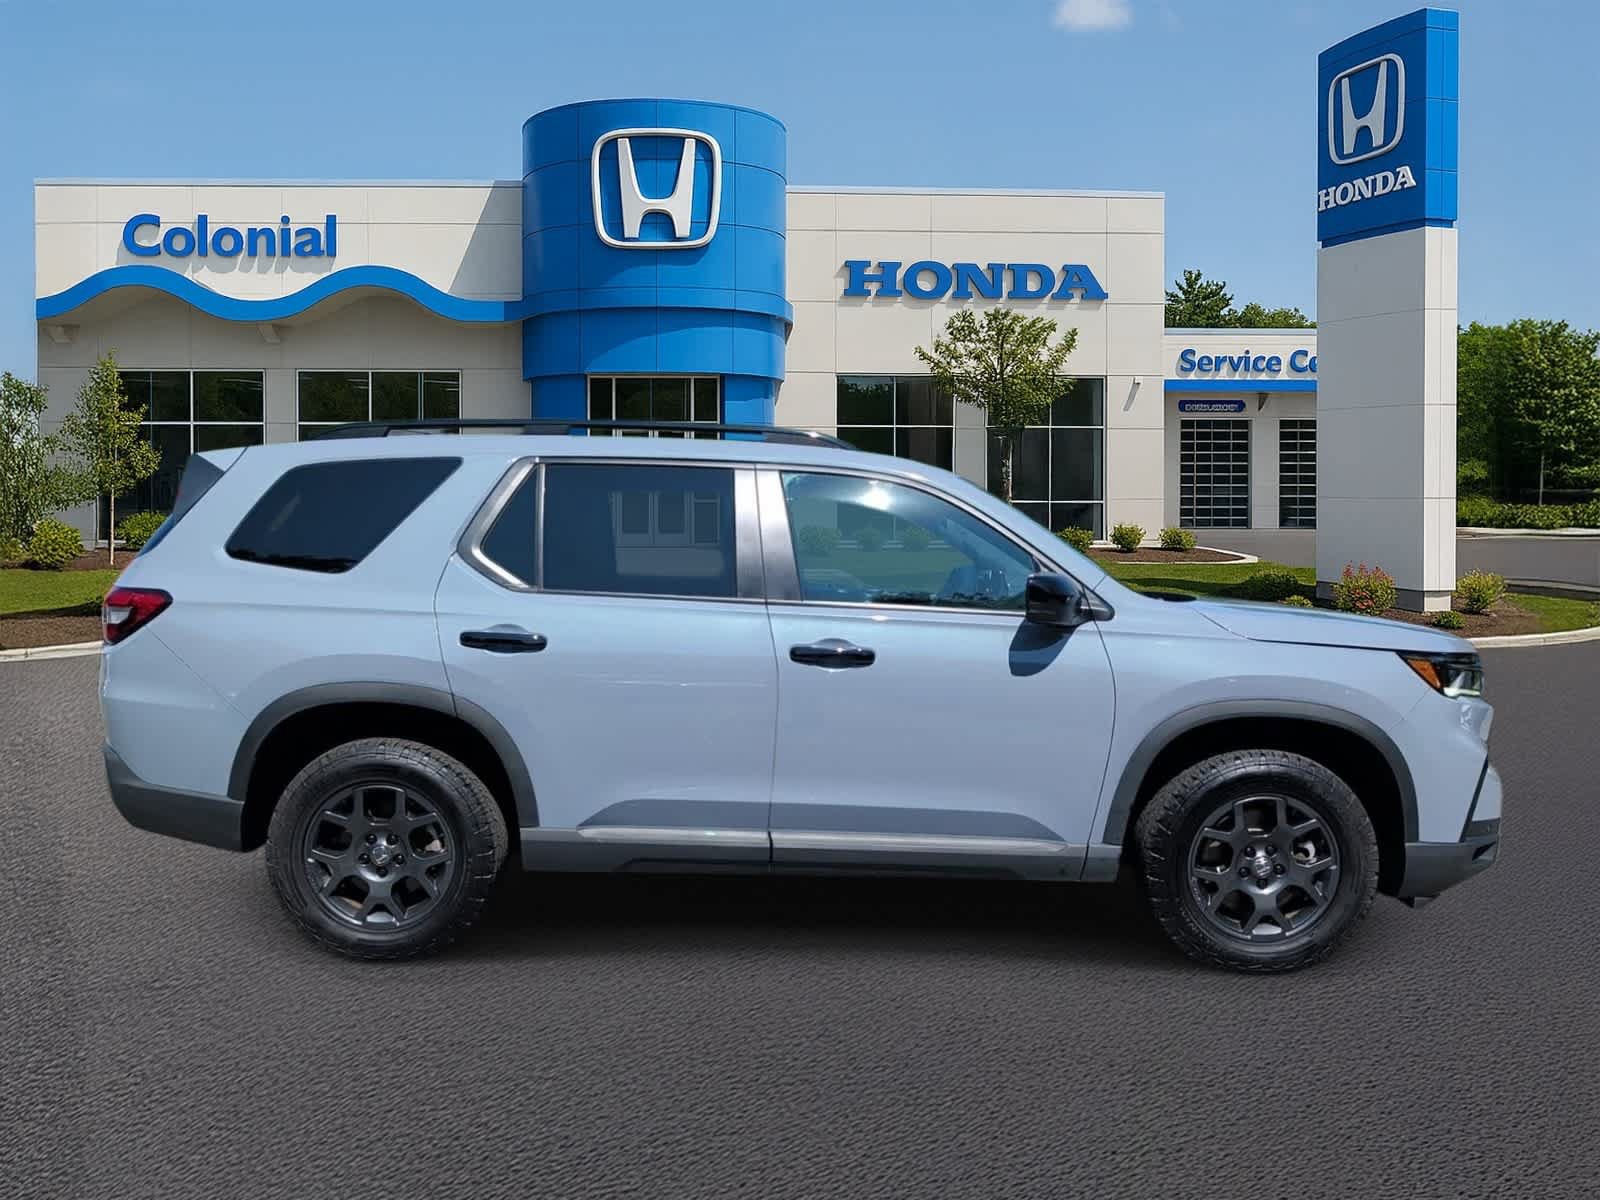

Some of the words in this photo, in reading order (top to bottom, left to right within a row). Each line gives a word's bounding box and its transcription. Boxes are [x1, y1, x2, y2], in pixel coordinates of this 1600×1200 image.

[1318, 165, 1417, 212] HONDA
[122, 213, 337, 257] Colonial
[843, 259, 1108, 300] HONDA
[1180, 348, 1282, 373] Service
